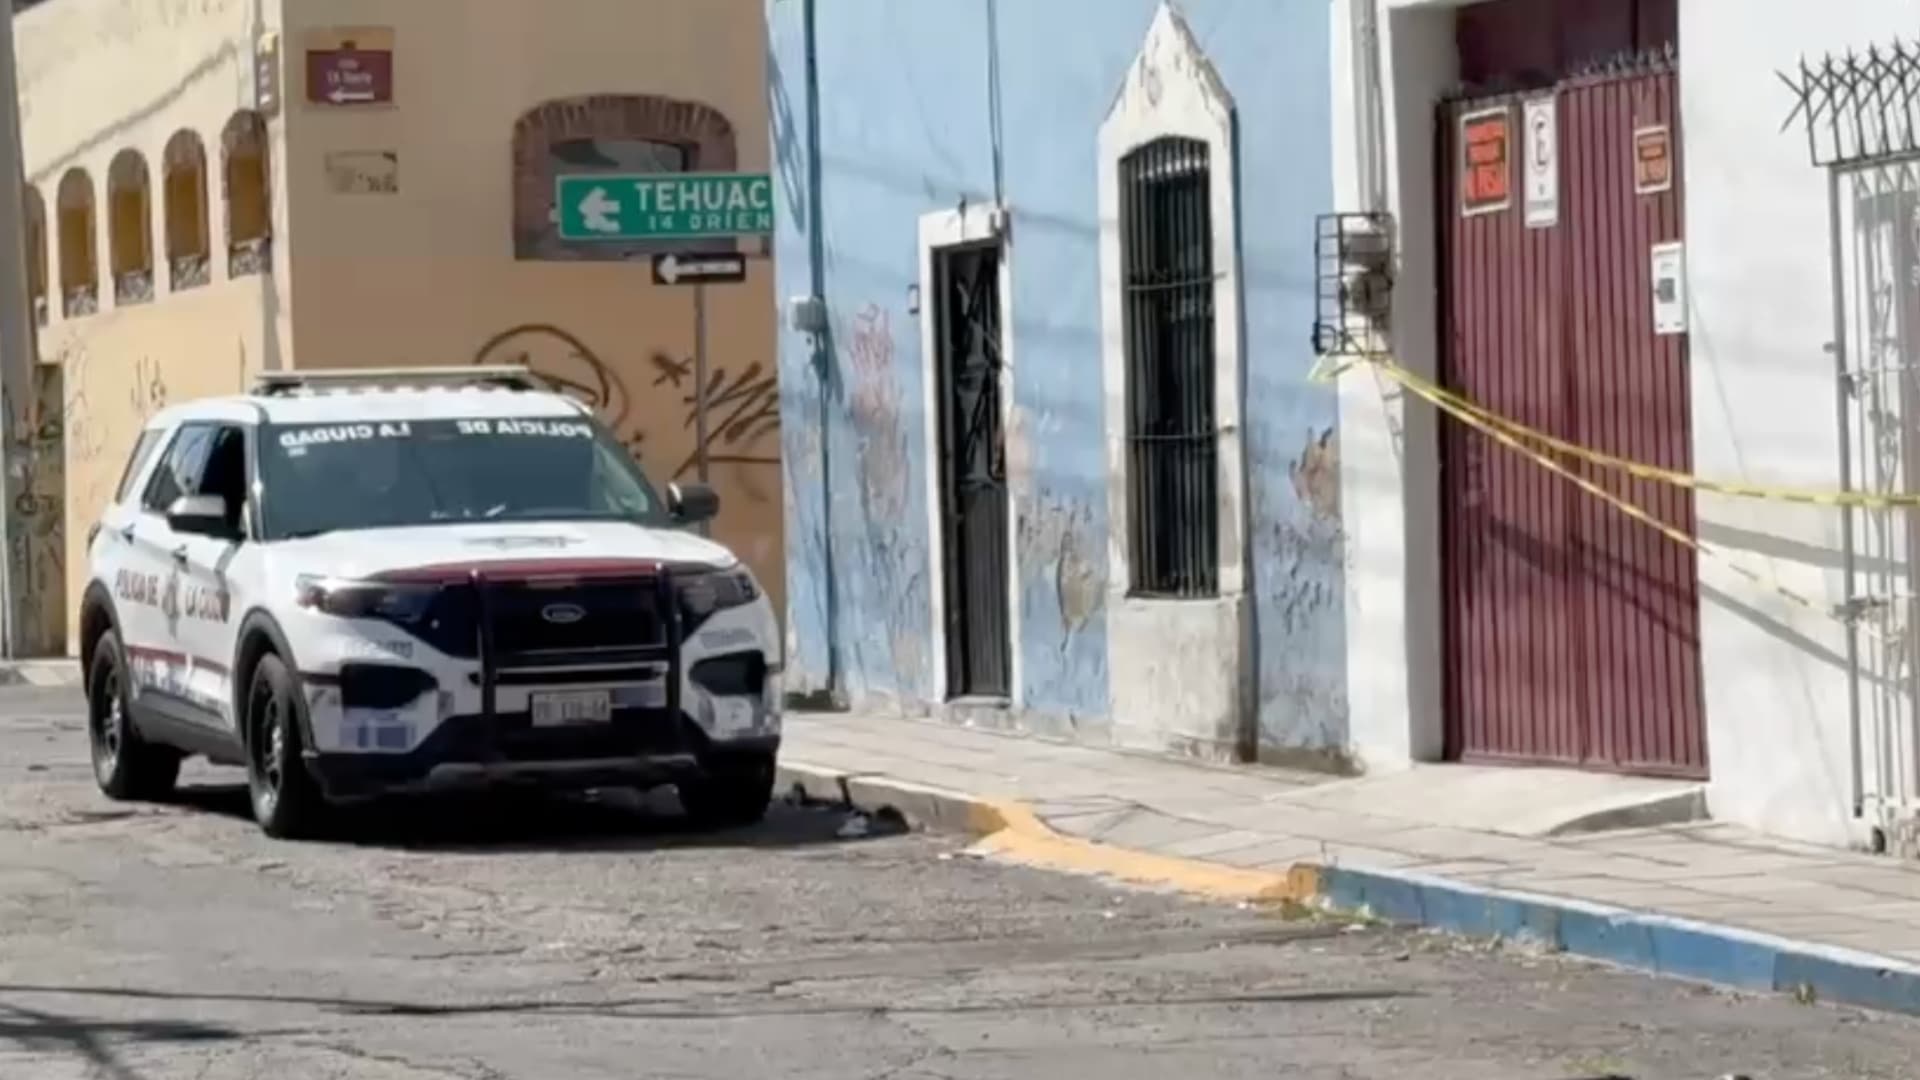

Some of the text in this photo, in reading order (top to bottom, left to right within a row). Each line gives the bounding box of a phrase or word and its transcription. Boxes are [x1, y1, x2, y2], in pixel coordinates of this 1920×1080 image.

[634, 180, 768, 212] TEHUAC
[649, 212, 771, 231] 14 ORIEN
